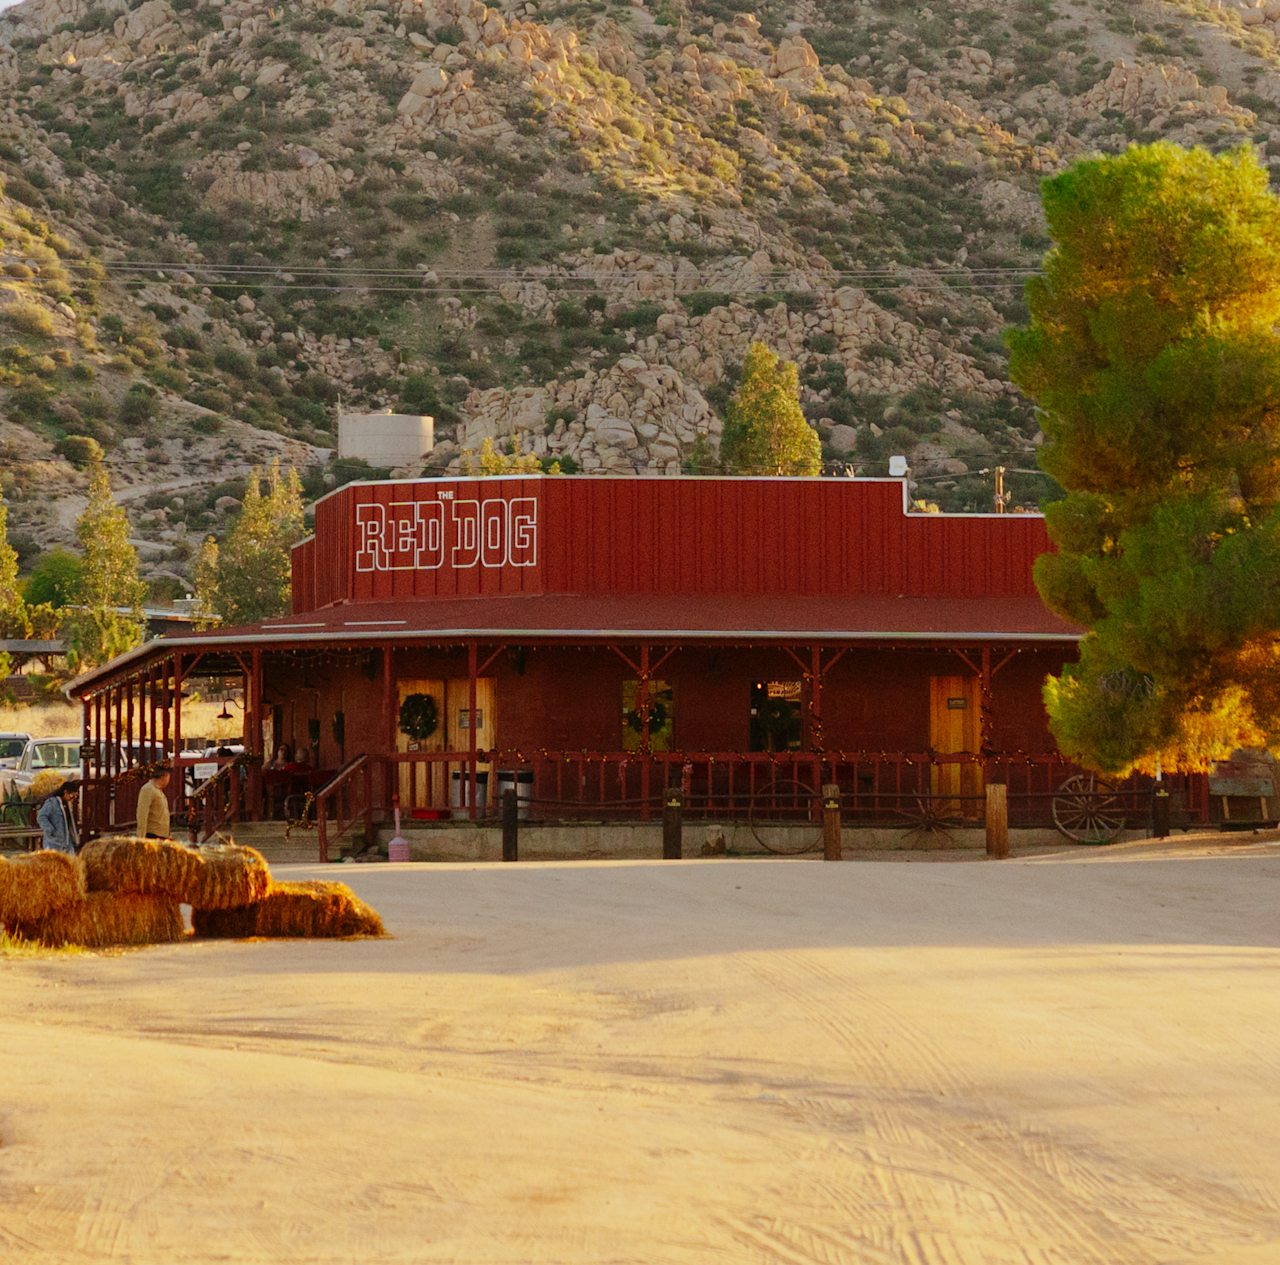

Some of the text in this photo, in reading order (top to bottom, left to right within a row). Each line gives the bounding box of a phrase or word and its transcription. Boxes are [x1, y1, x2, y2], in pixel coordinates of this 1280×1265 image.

[437, 491, 454, 500] THE
[356, 497, 538, 573] RED DOG
